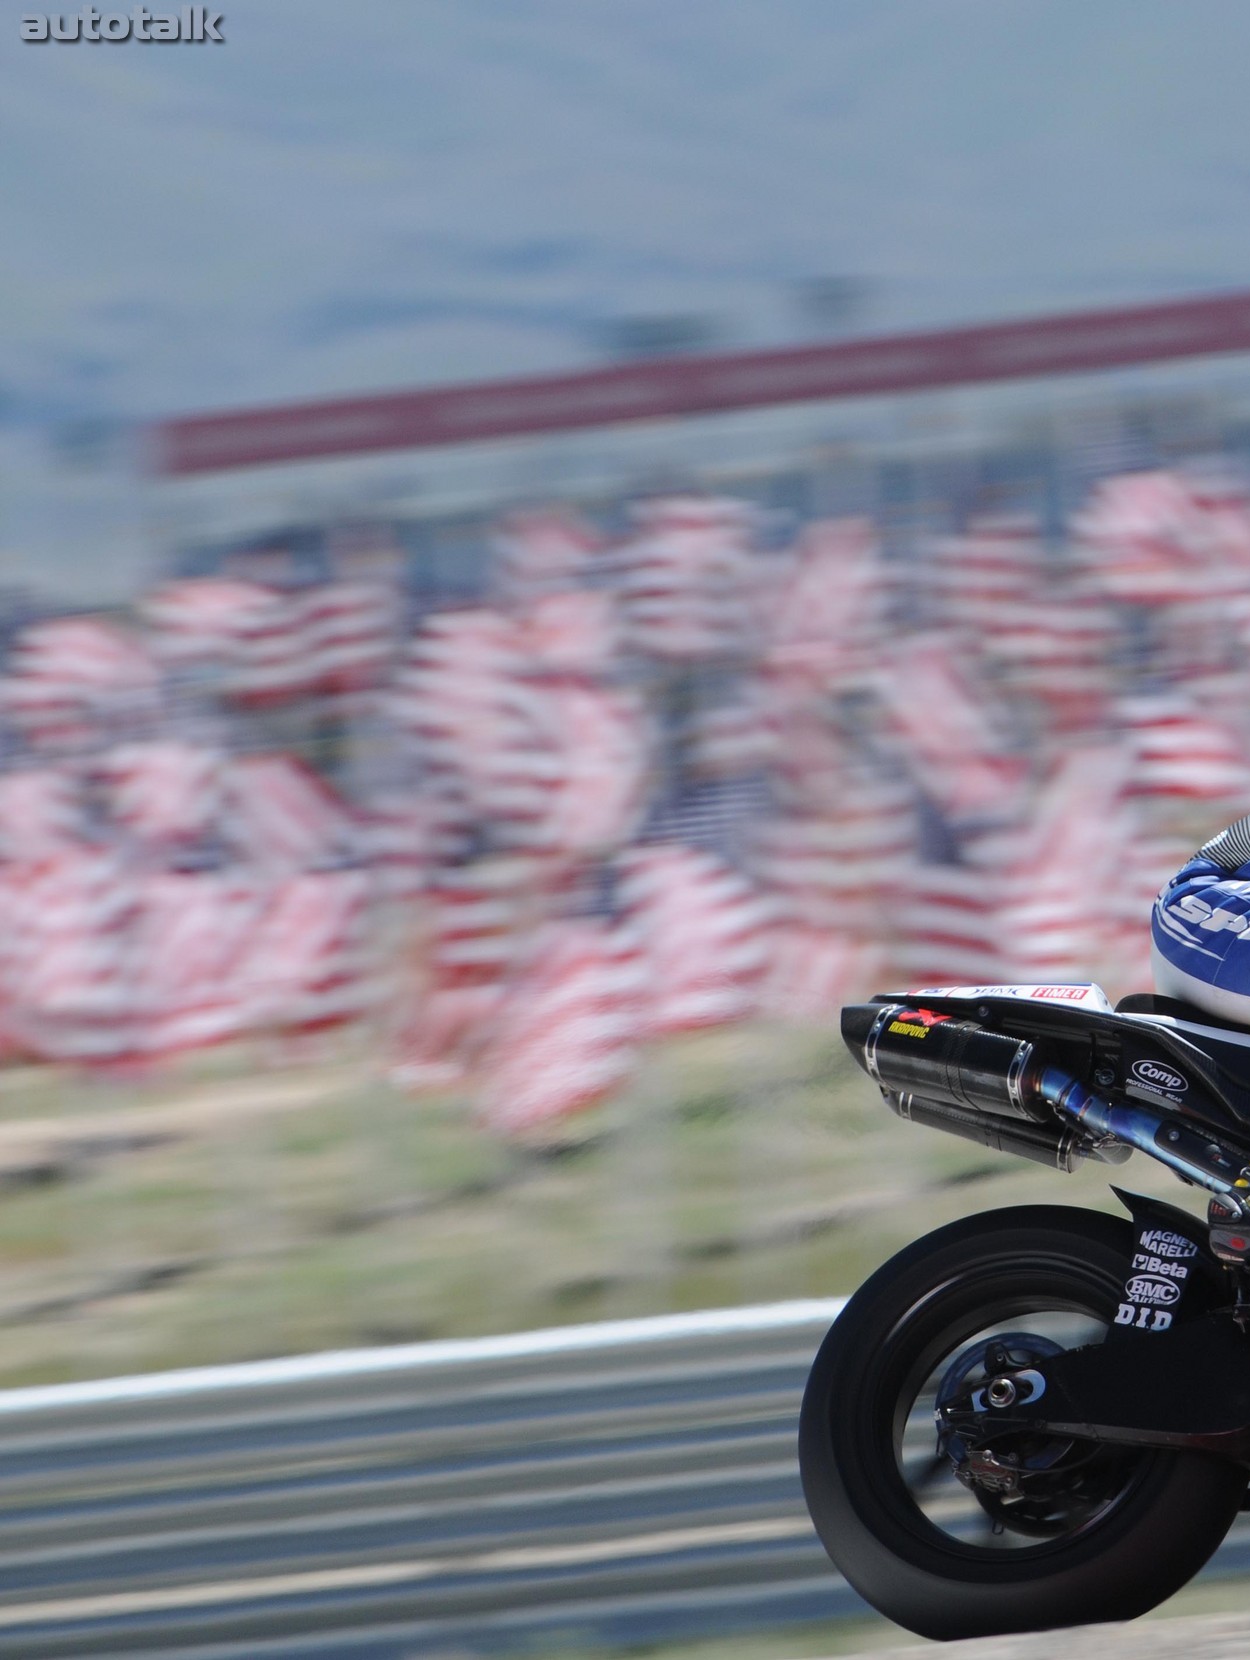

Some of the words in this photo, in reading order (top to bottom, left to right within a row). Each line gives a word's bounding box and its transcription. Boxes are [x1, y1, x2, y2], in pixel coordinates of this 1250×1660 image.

[1138, 1062, 1182, 1088] Comp
[1146, 1256, 1188, 1279] Beta
[1129, 1279, 1175, 1301] BMC
